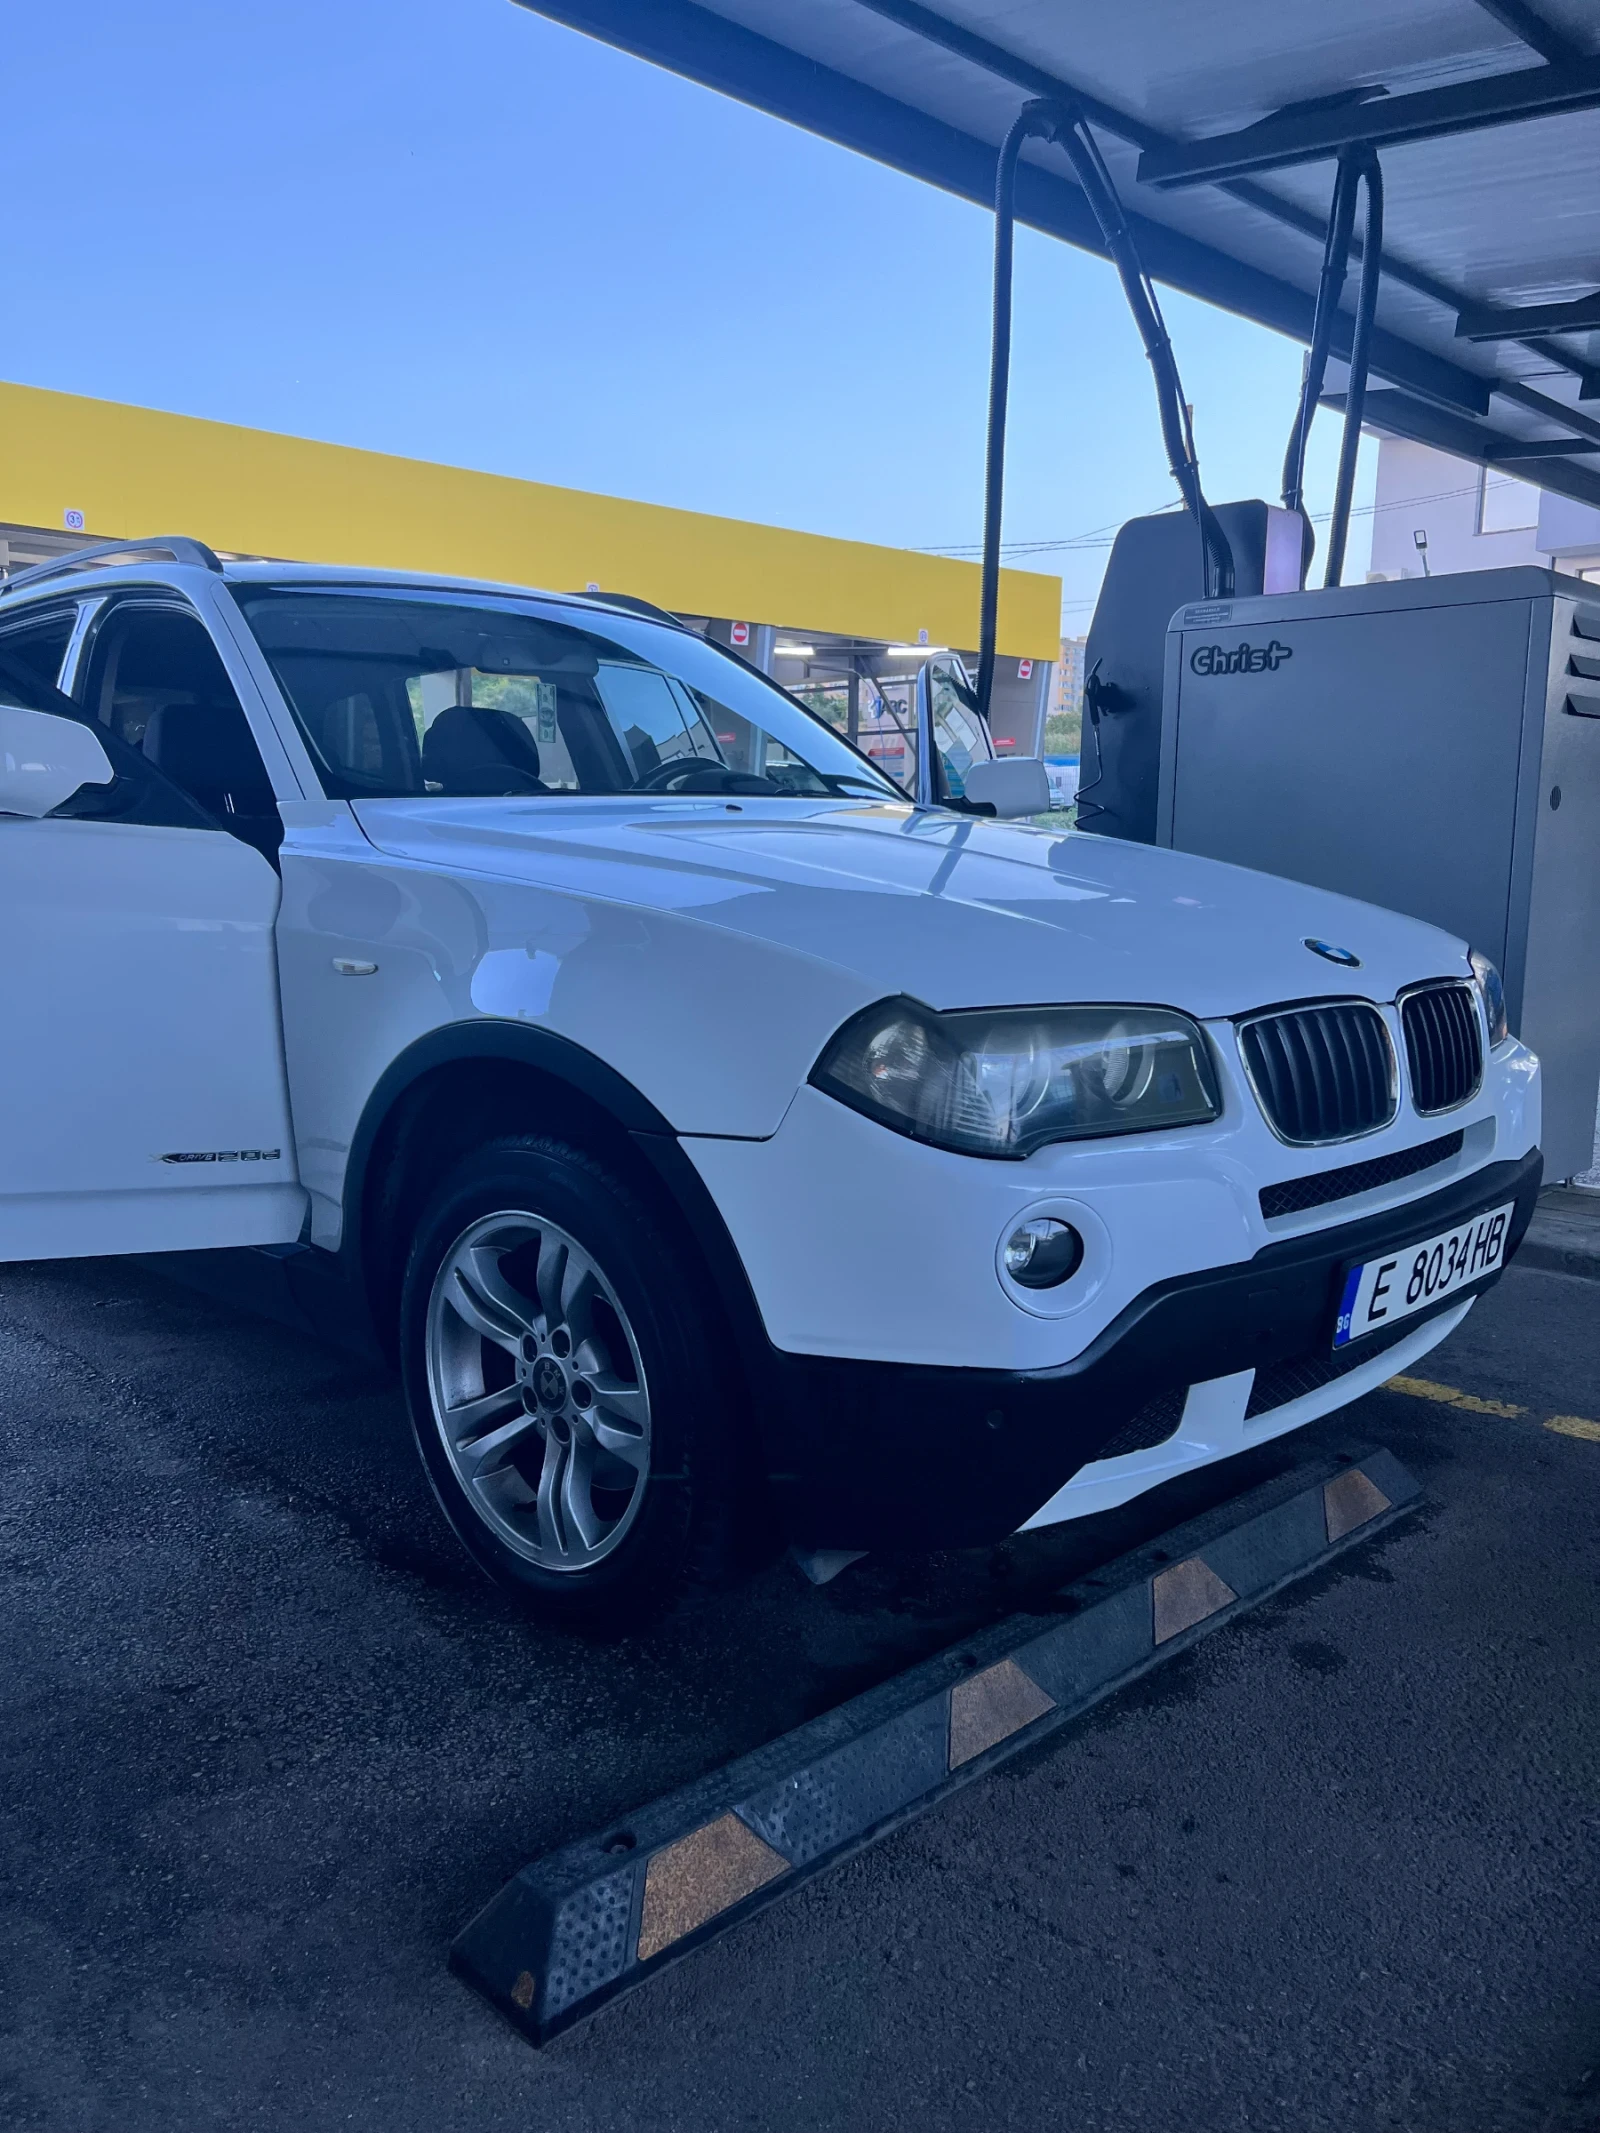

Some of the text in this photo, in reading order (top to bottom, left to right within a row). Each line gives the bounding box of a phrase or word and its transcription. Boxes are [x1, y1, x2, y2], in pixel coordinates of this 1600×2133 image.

[1190, 640, 1293, 676] Christ
[1367, 1212, 1506, 1322] E 8034 HB
[1336, 1313, 1350, 1334] BG
[544, 1361, 565, 1396] BMW
